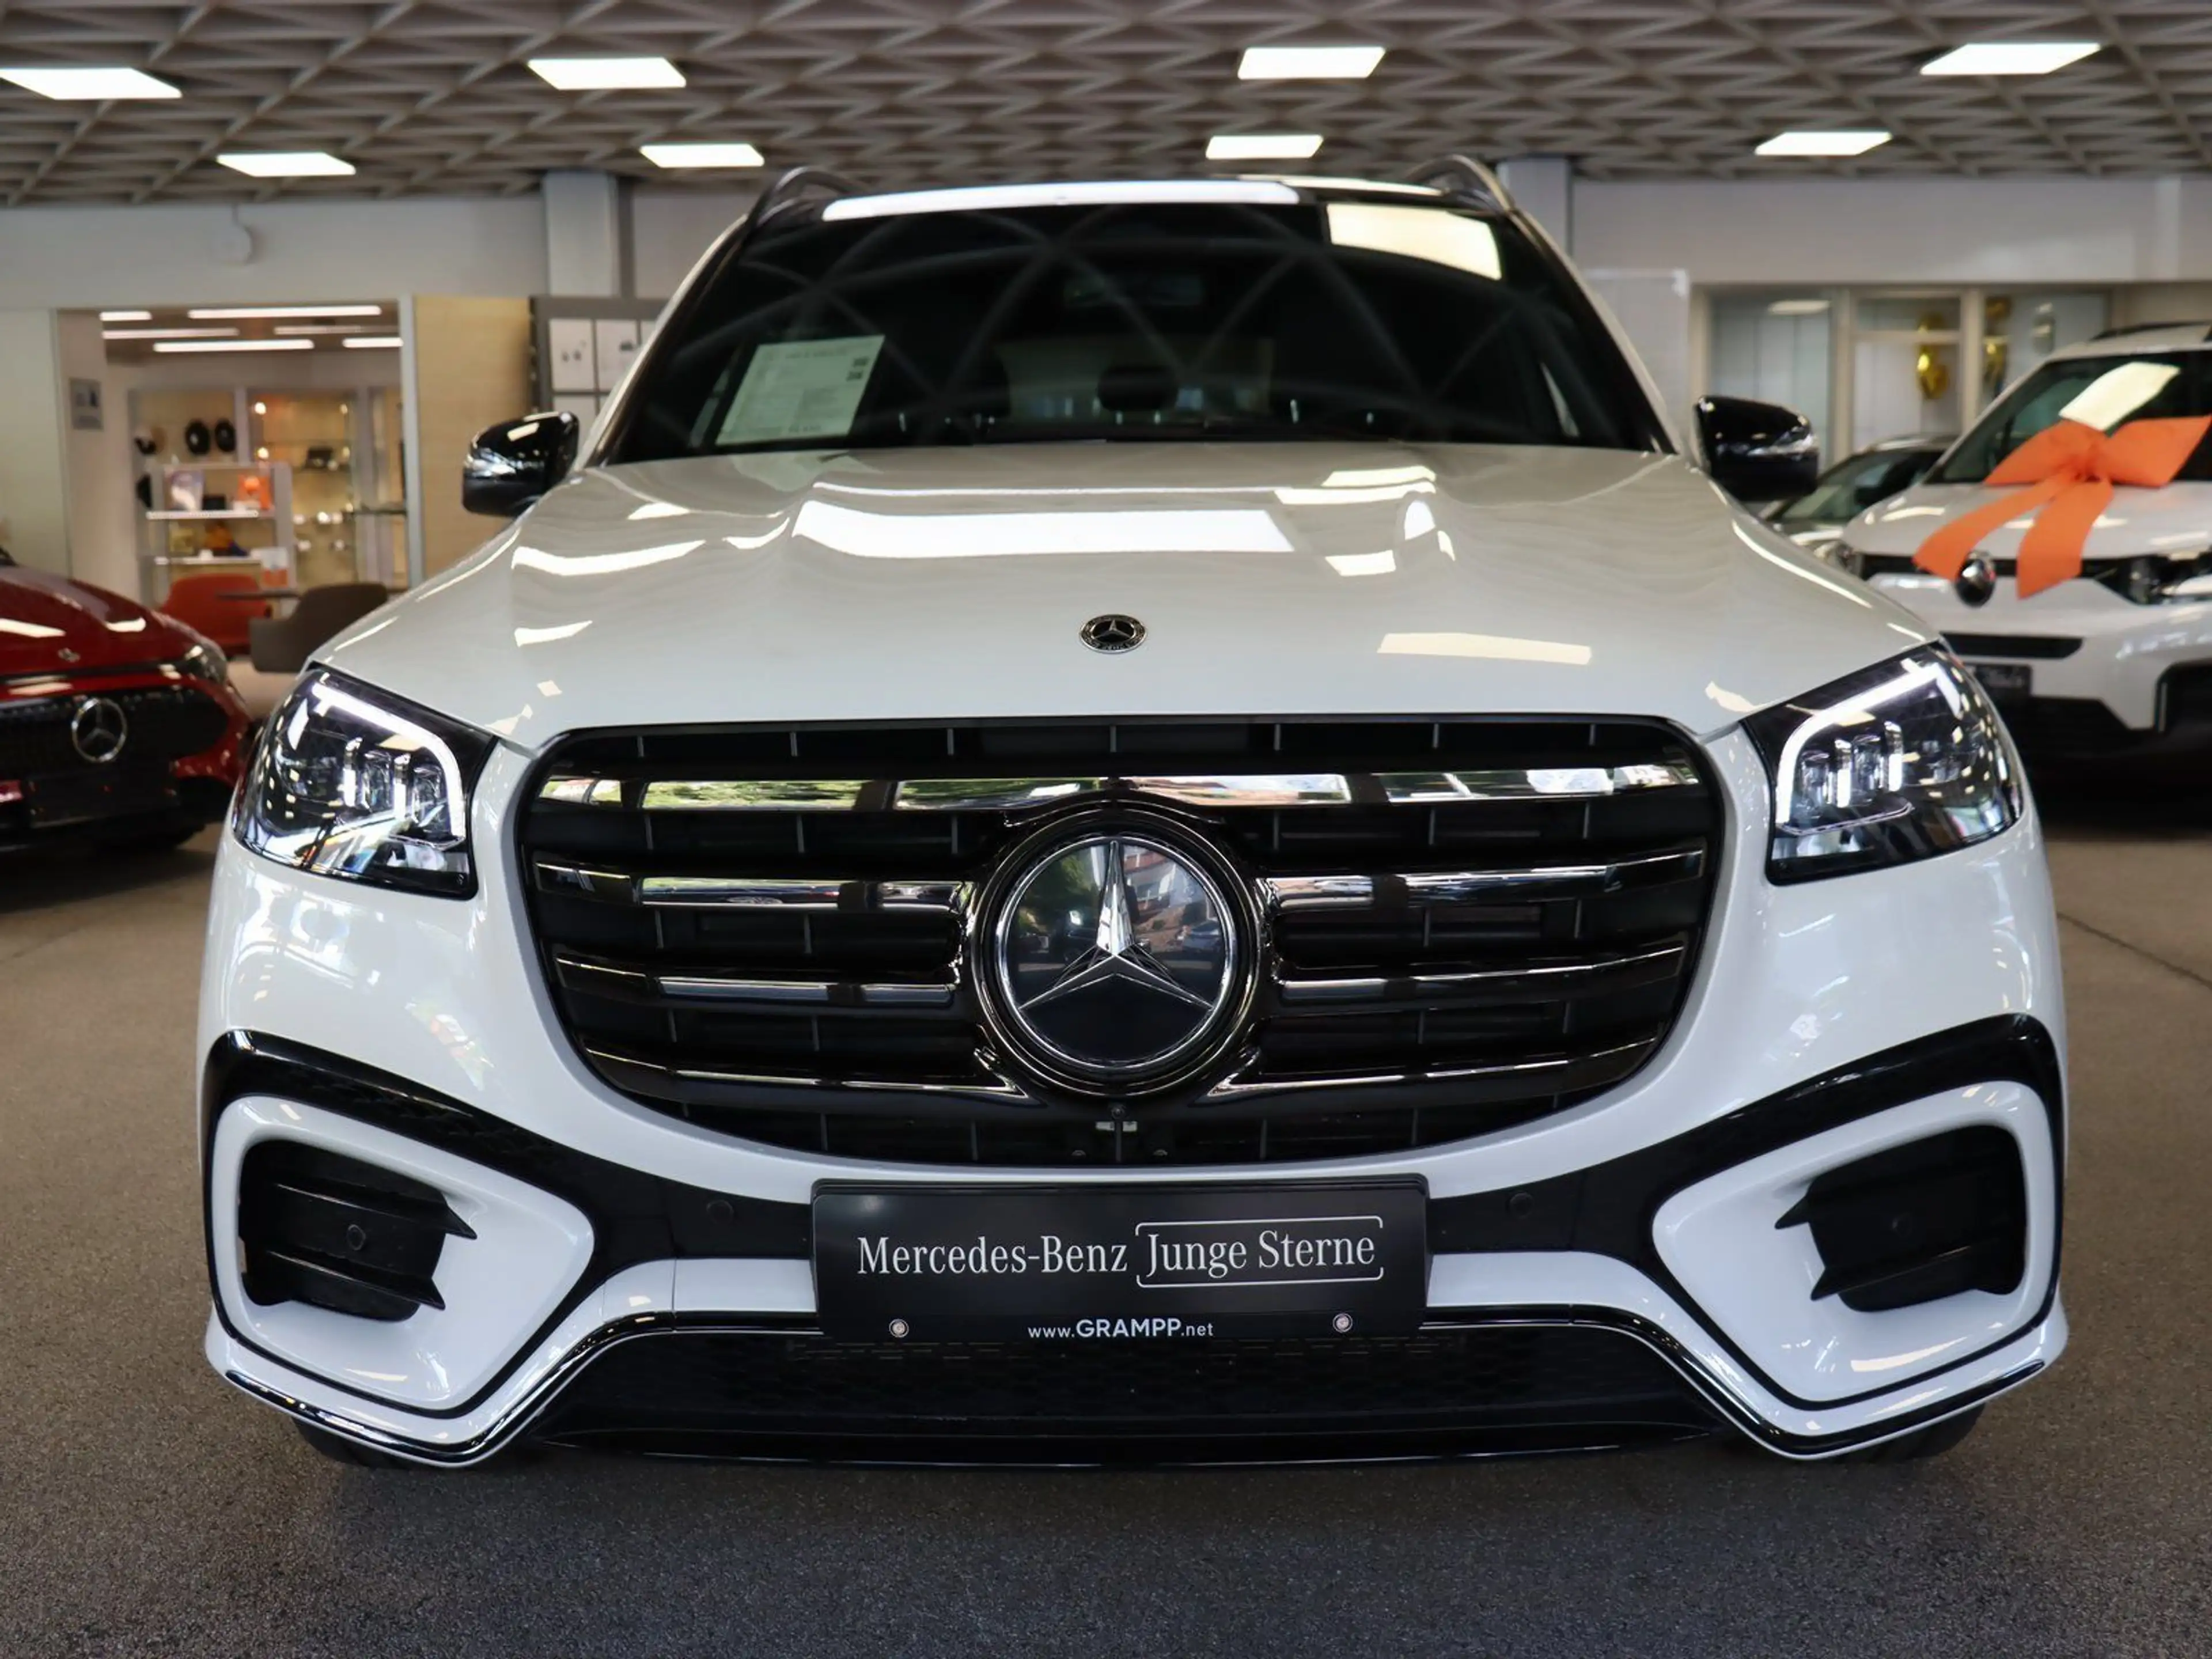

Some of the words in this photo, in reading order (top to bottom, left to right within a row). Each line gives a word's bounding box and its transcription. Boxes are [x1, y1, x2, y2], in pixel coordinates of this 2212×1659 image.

[857, 1235, 1127, 1274] Mercedes-Benz
[1146, 1233, 1247, 1279] Junge
[1259, 1230, 1374, 1268] Sterne
[1028, 1318, 1213, 1338] www.GRAMPP.net
